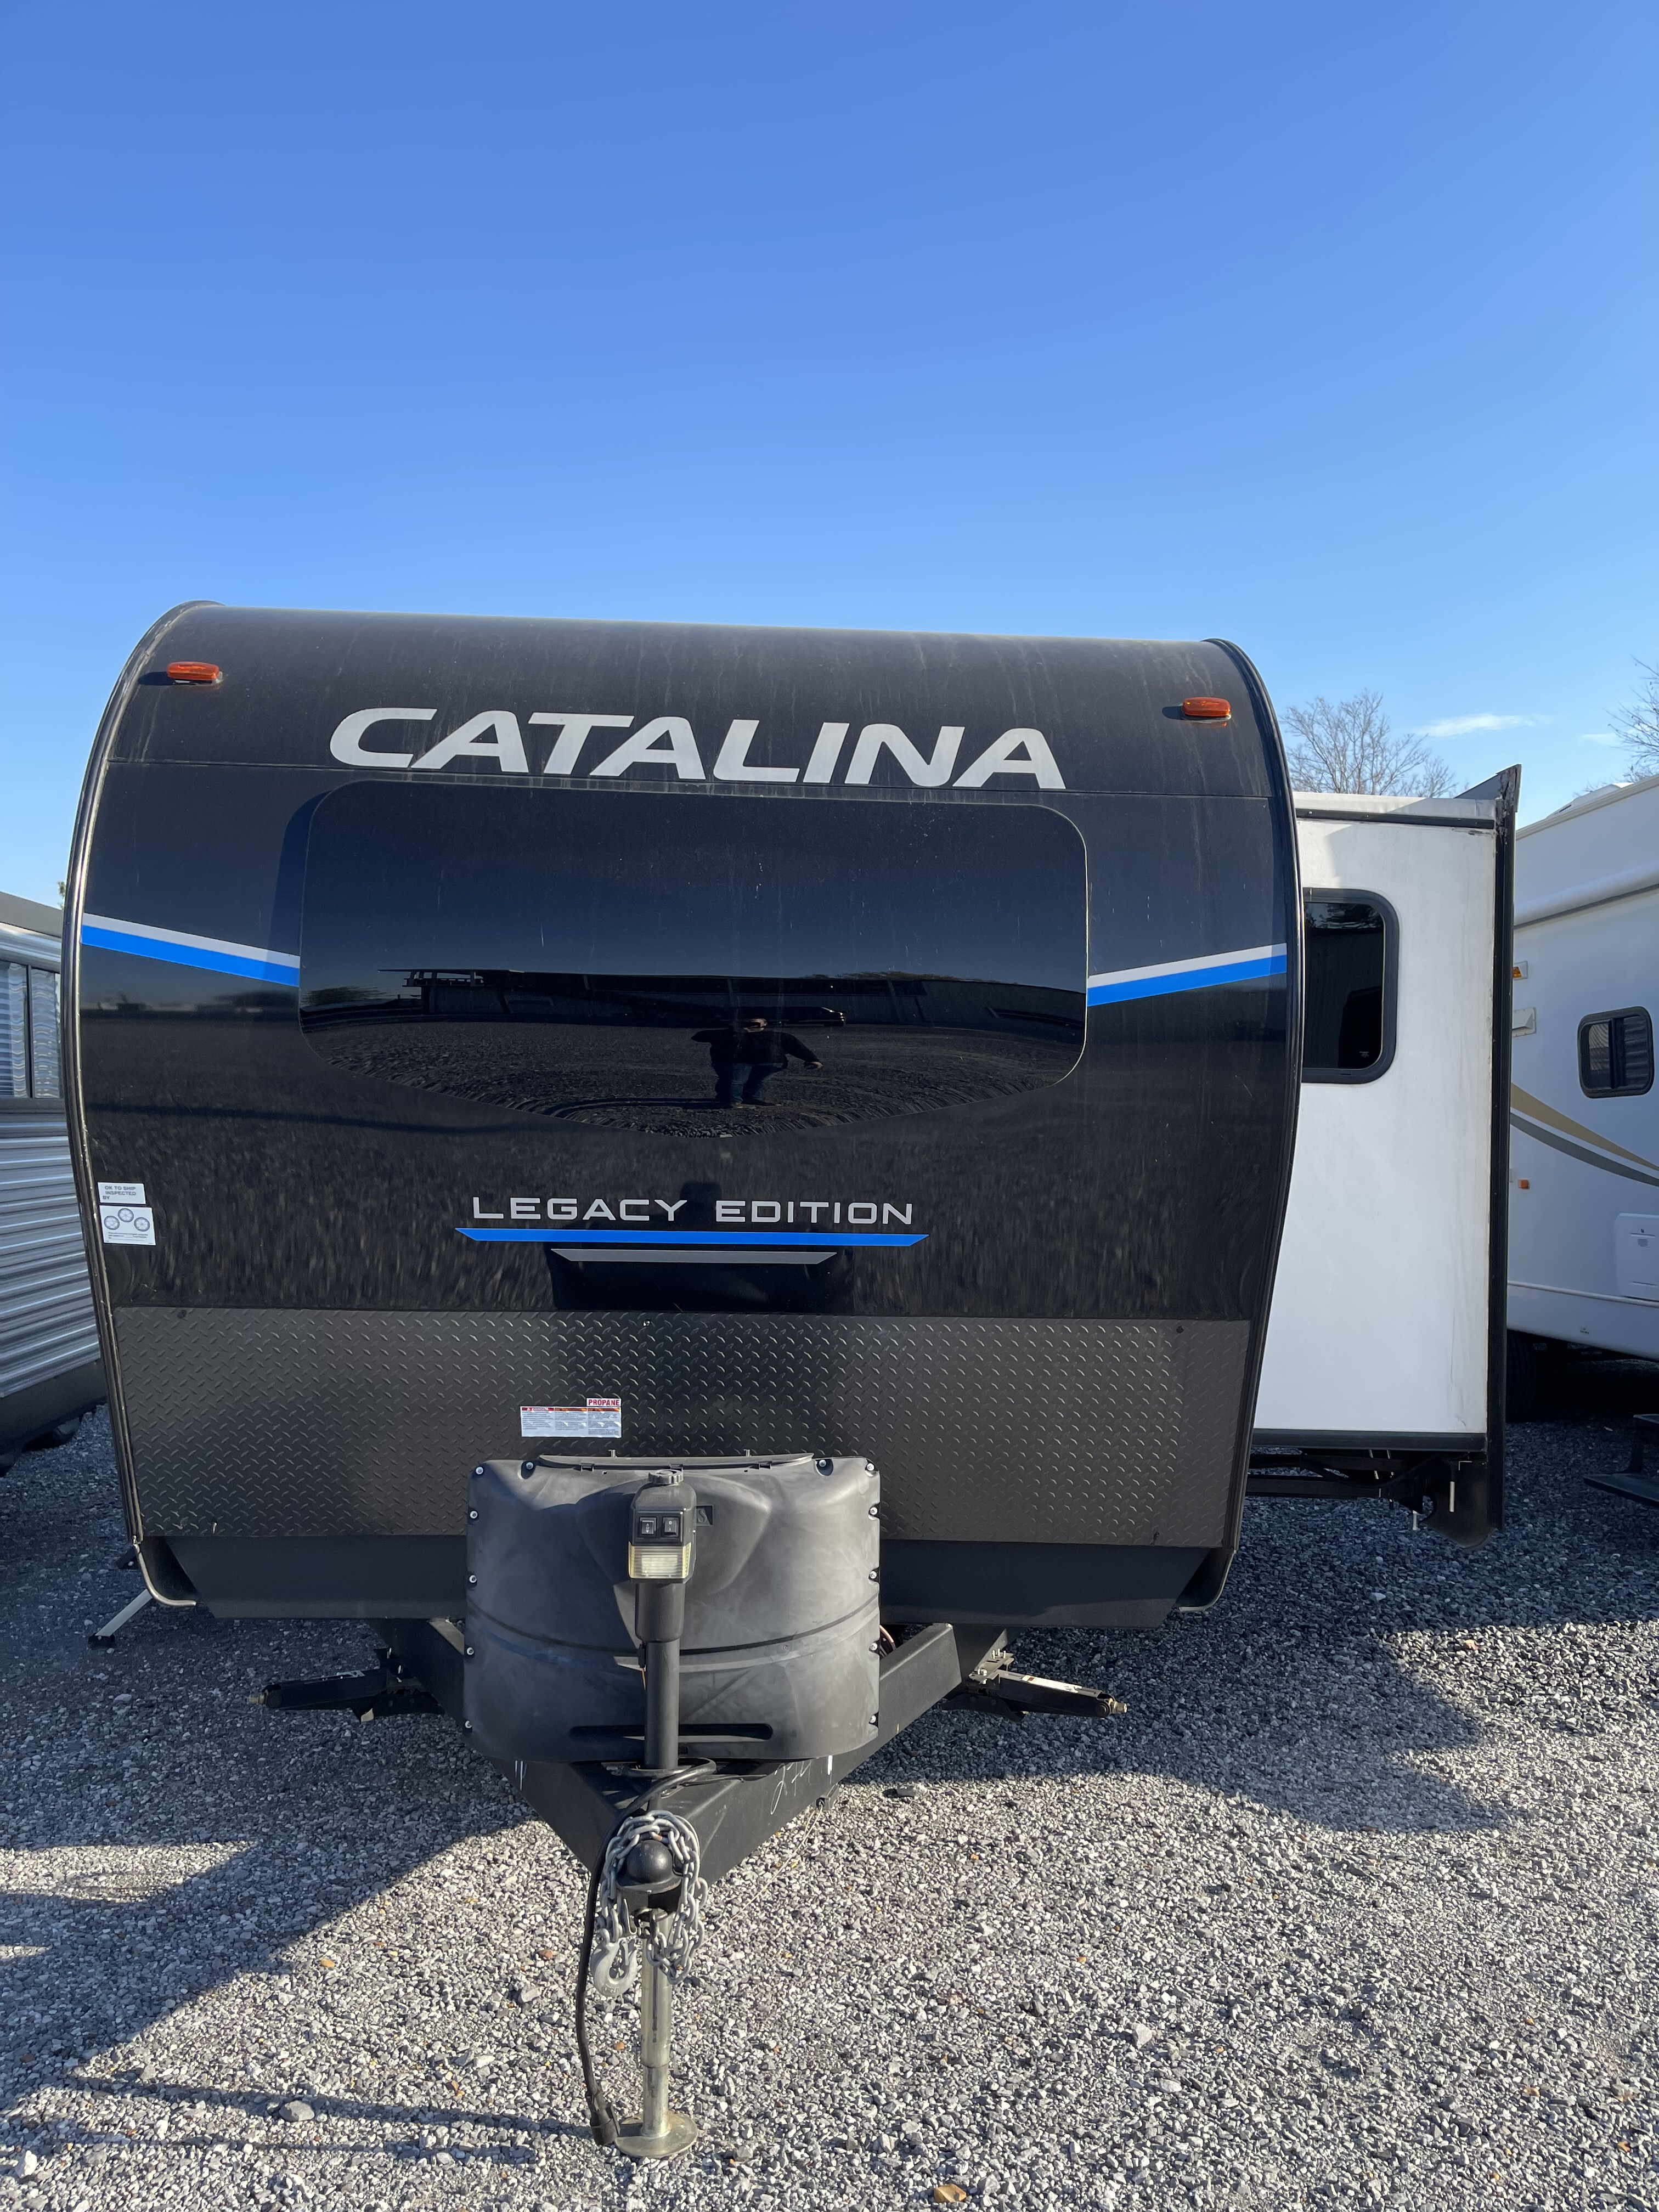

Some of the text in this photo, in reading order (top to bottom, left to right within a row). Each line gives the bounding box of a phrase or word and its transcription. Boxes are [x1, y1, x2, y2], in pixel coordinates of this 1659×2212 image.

[330, 707, 1066, 789] CATALINA
[473, 1197, 912, 1224] LEGACY EDITION
